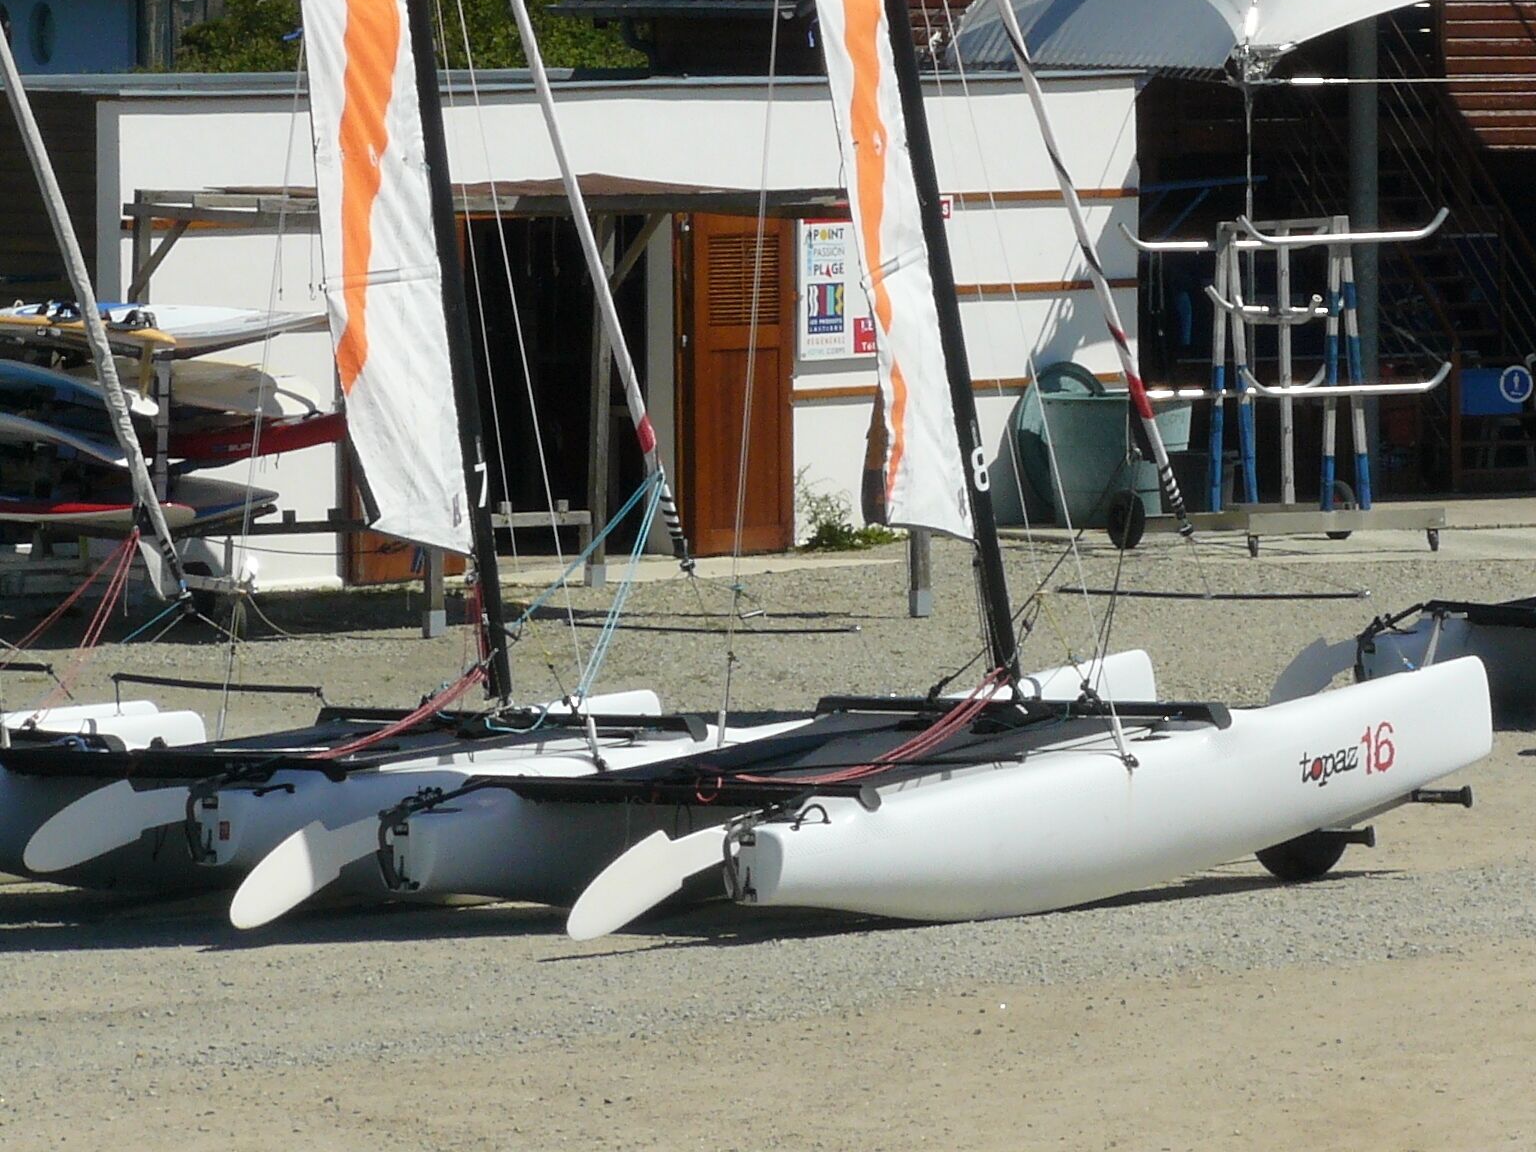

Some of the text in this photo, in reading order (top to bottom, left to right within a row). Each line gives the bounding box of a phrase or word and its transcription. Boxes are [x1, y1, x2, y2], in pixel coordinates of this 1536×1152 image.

[813, 227, 844, 241] POINT
[813, 262, 844, 278] PLAGE
[473, 461, 489, 508] 7
[970, 446, 991, 493] 8
[1299, 721, 1396, 788] topaz 16
